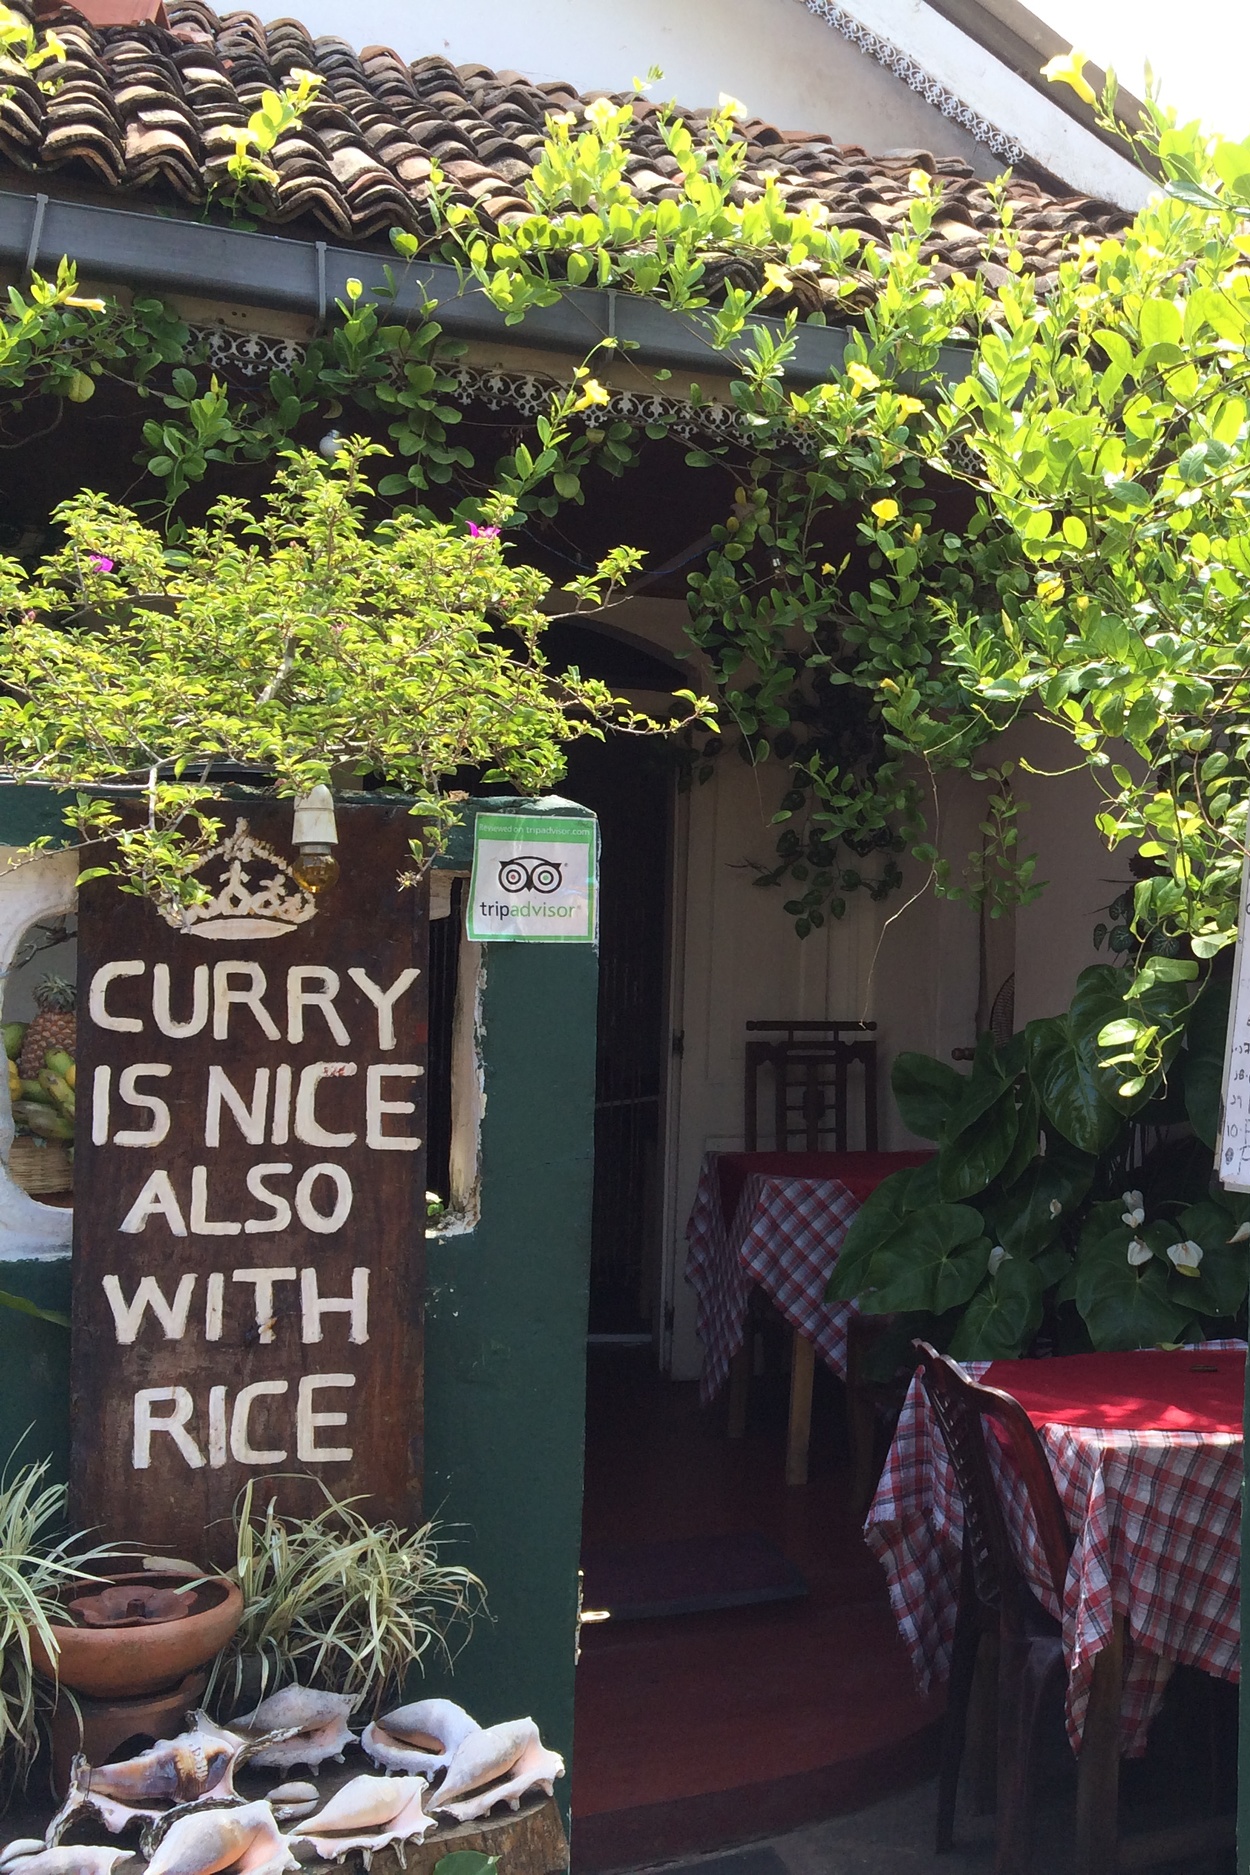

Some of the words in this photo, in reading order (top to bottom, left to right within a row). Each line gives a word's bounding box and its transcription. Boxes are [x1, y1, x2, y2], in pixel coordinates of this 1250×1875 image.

[526, 826, 590, 836] tripadvisor.com
[480, 900, 576, 920] tripadvisor
[89, 960, 421, 1051] CURRY
[91, 1063, 172, 1147] IS
[205, 1061, 424, 1151] NICE
[119, 1162, 354, 1237] ALSO
[102, 1266, 371, 1345] WITH
[132, 1373, 357, 1469] RICE
